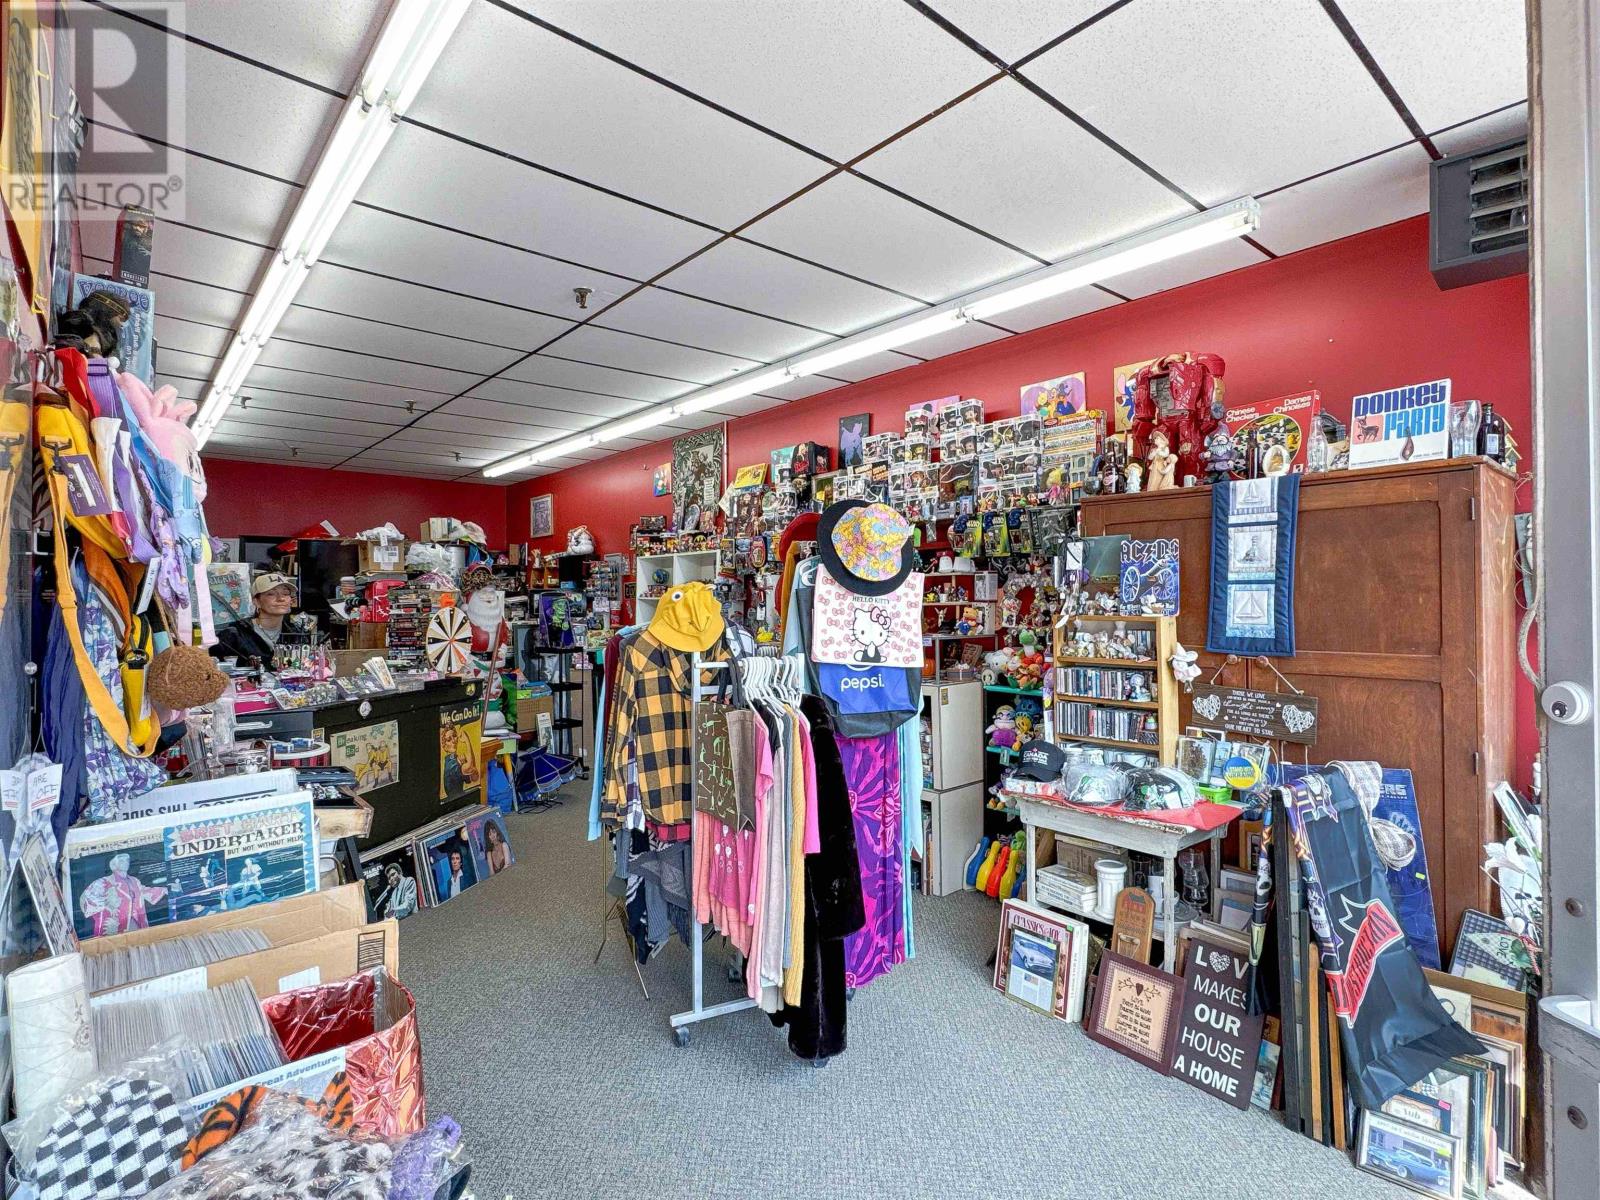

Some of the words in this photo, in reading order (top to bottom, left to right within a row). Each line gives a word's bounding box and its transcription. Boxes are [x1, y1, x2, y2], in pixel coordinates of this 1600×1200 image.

[1226, 406, 1256, 417] Chinese
[441, 711, 451, 724] We
[451, 709, 463, 723] Can
[463, 707, 472, 719] Do
[172, 821, 305, 857] UNDERTAKER
[180, 825, 232, 843] BRET
[227, 847, 240, 856] BUT
[242, 843, 254, 852] NOT
[257, 838, 285, 850] WITHOUT
[1194, 1003, 1241, 1038] OUR
[1182, 1026, 1245, 1070] HOUSE
[1174, 1055, 1186, 1073] A
[1188, 1060, 1239, 1098] HOME
